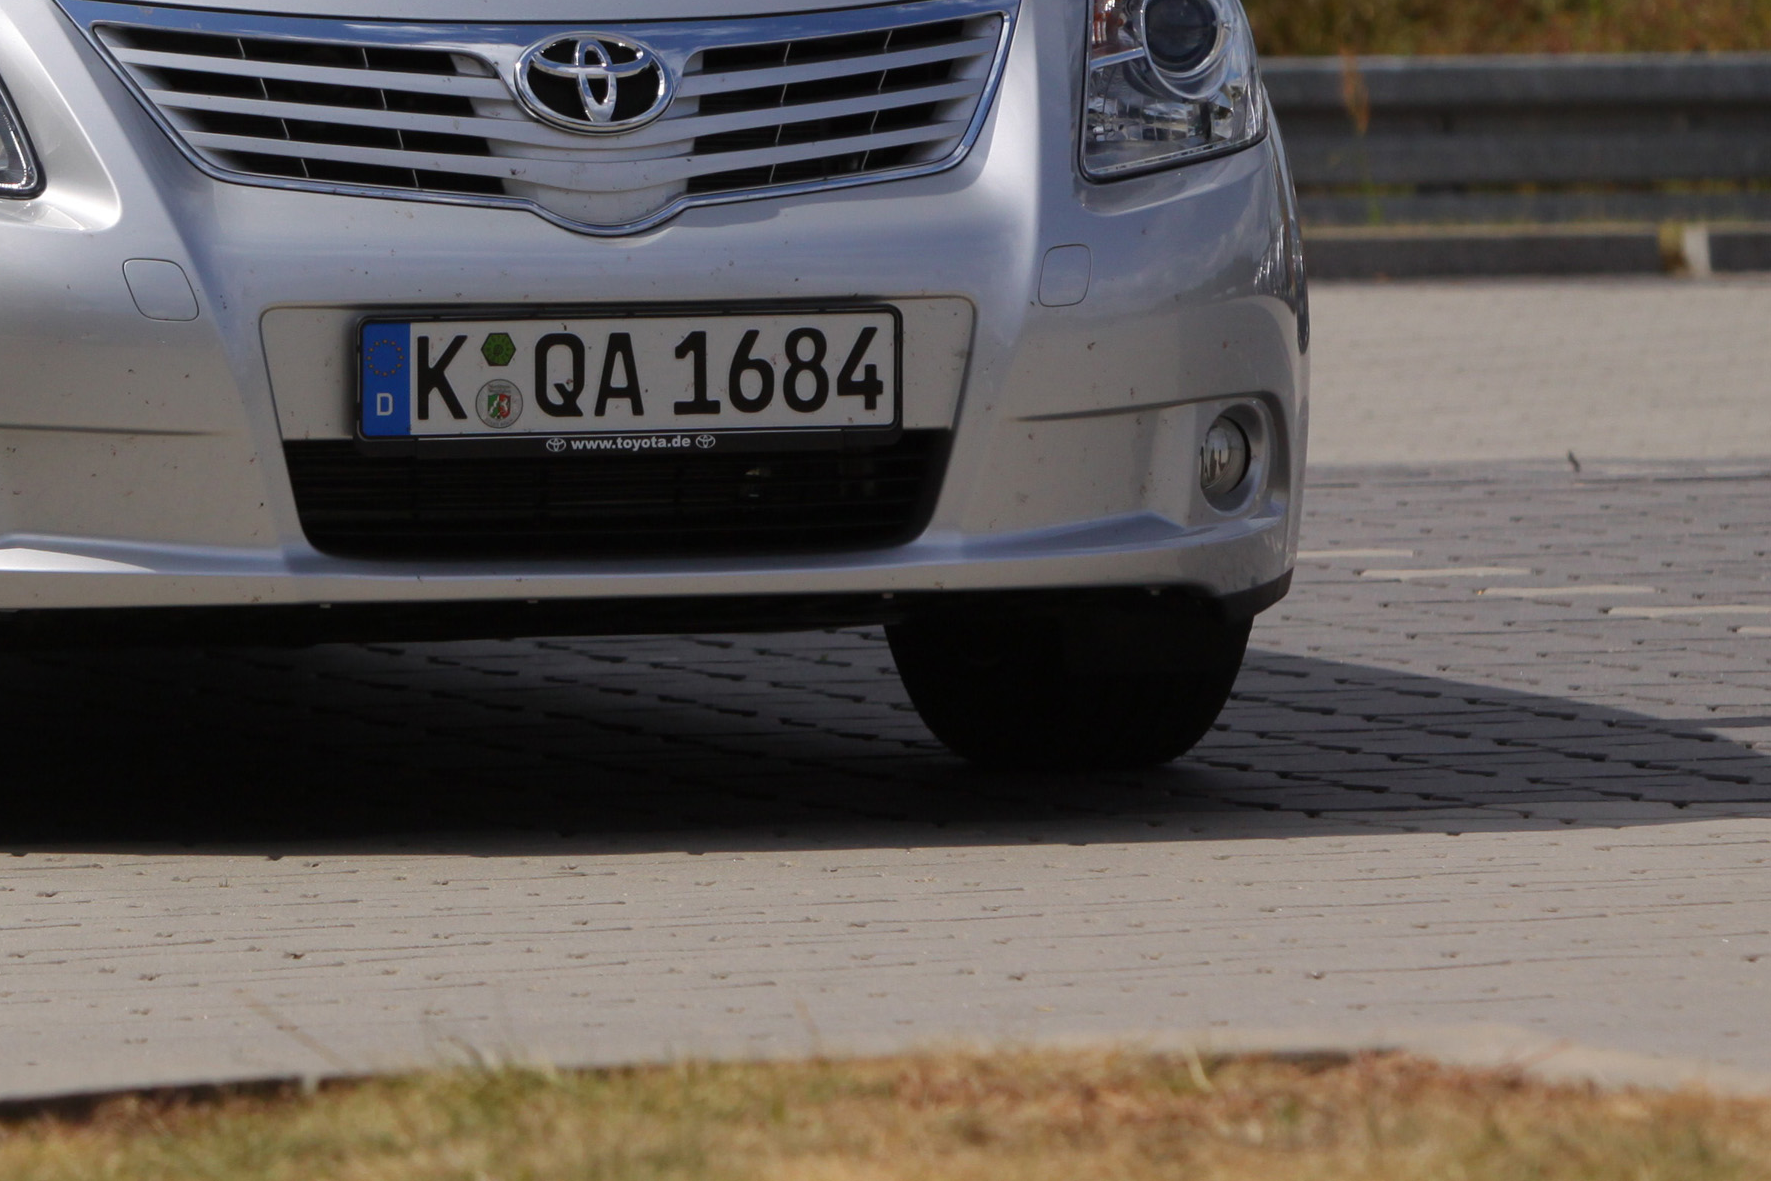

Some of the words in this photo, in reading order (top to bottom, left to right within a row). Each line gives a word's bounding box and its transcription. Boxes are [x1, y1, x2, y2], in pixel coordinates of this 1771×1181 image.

[376, 392, 393, 416] D
[416, 334, 468, 420] K
[534, 331, 645, 418] QA
[674, 326, 884, 416] 1684
[571, 435, 691, 451] www.toyota.de
